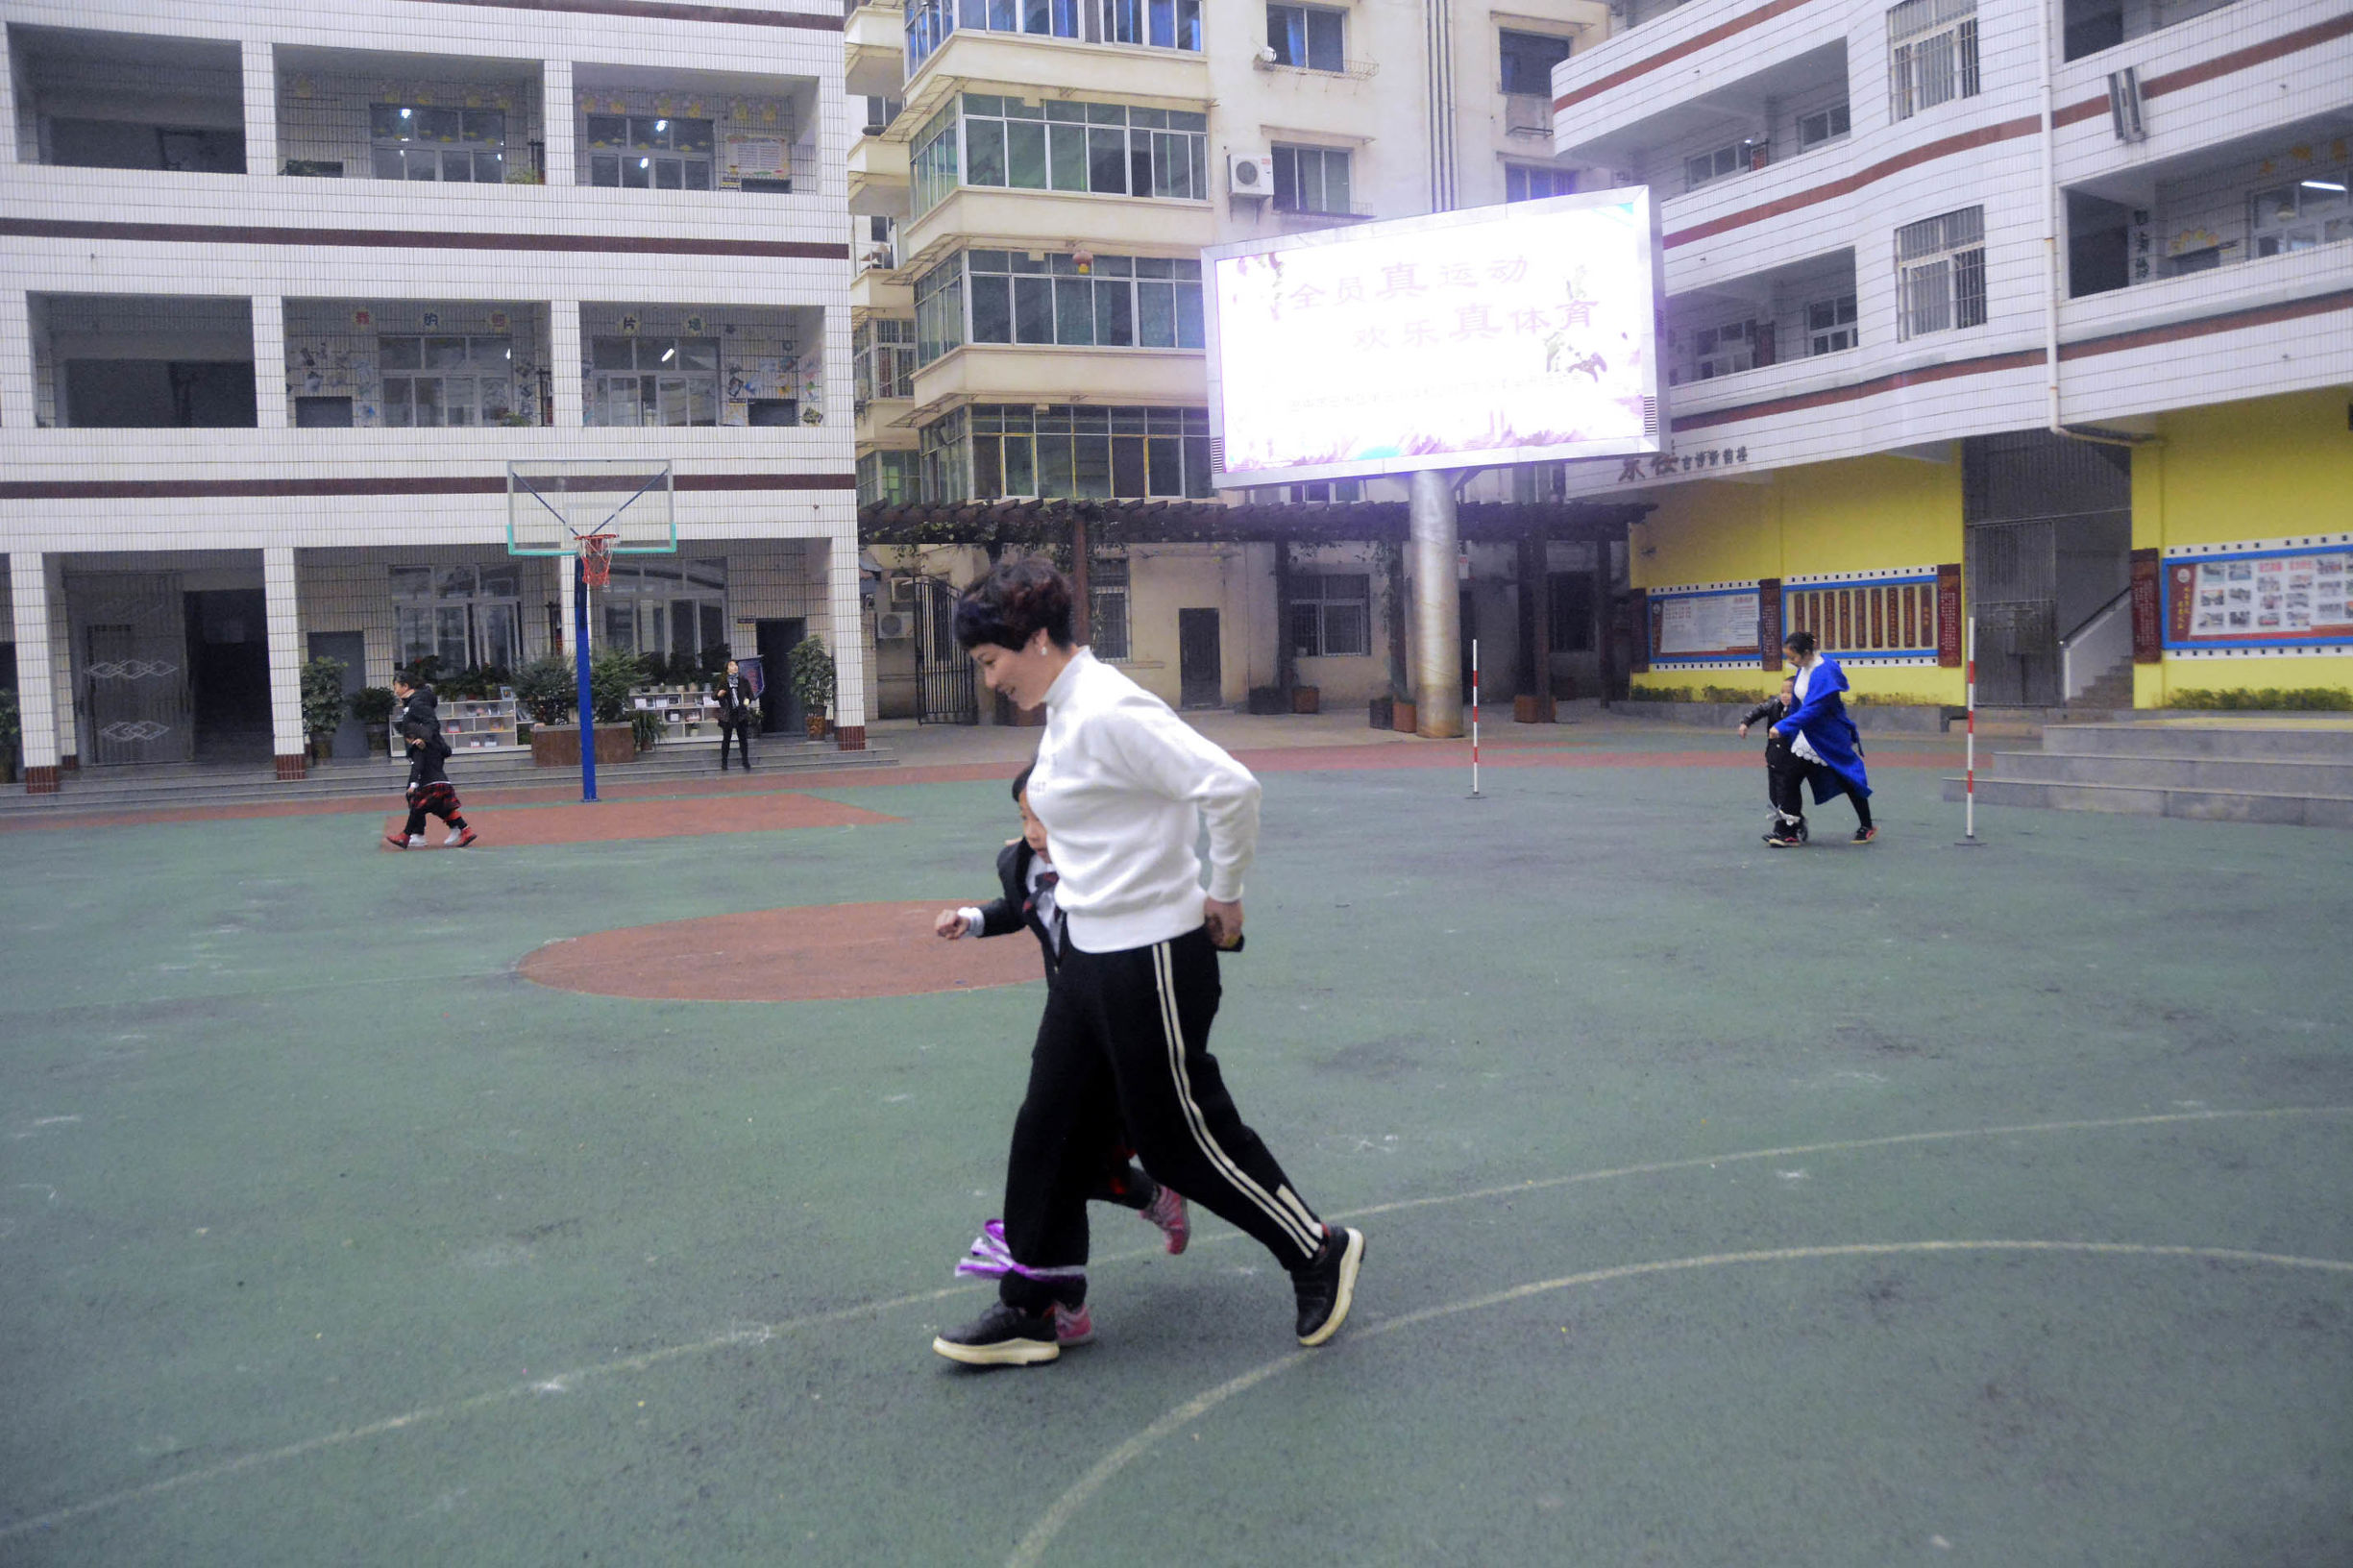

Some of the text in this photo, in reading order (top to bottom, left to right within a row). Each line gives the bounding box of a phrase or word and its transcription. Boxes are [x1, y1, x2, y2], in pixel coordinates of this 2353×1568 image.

[1288, 255, 1530, 311] 全员真运动
[1353, 299, 1600, 353] 欢乐真体育
